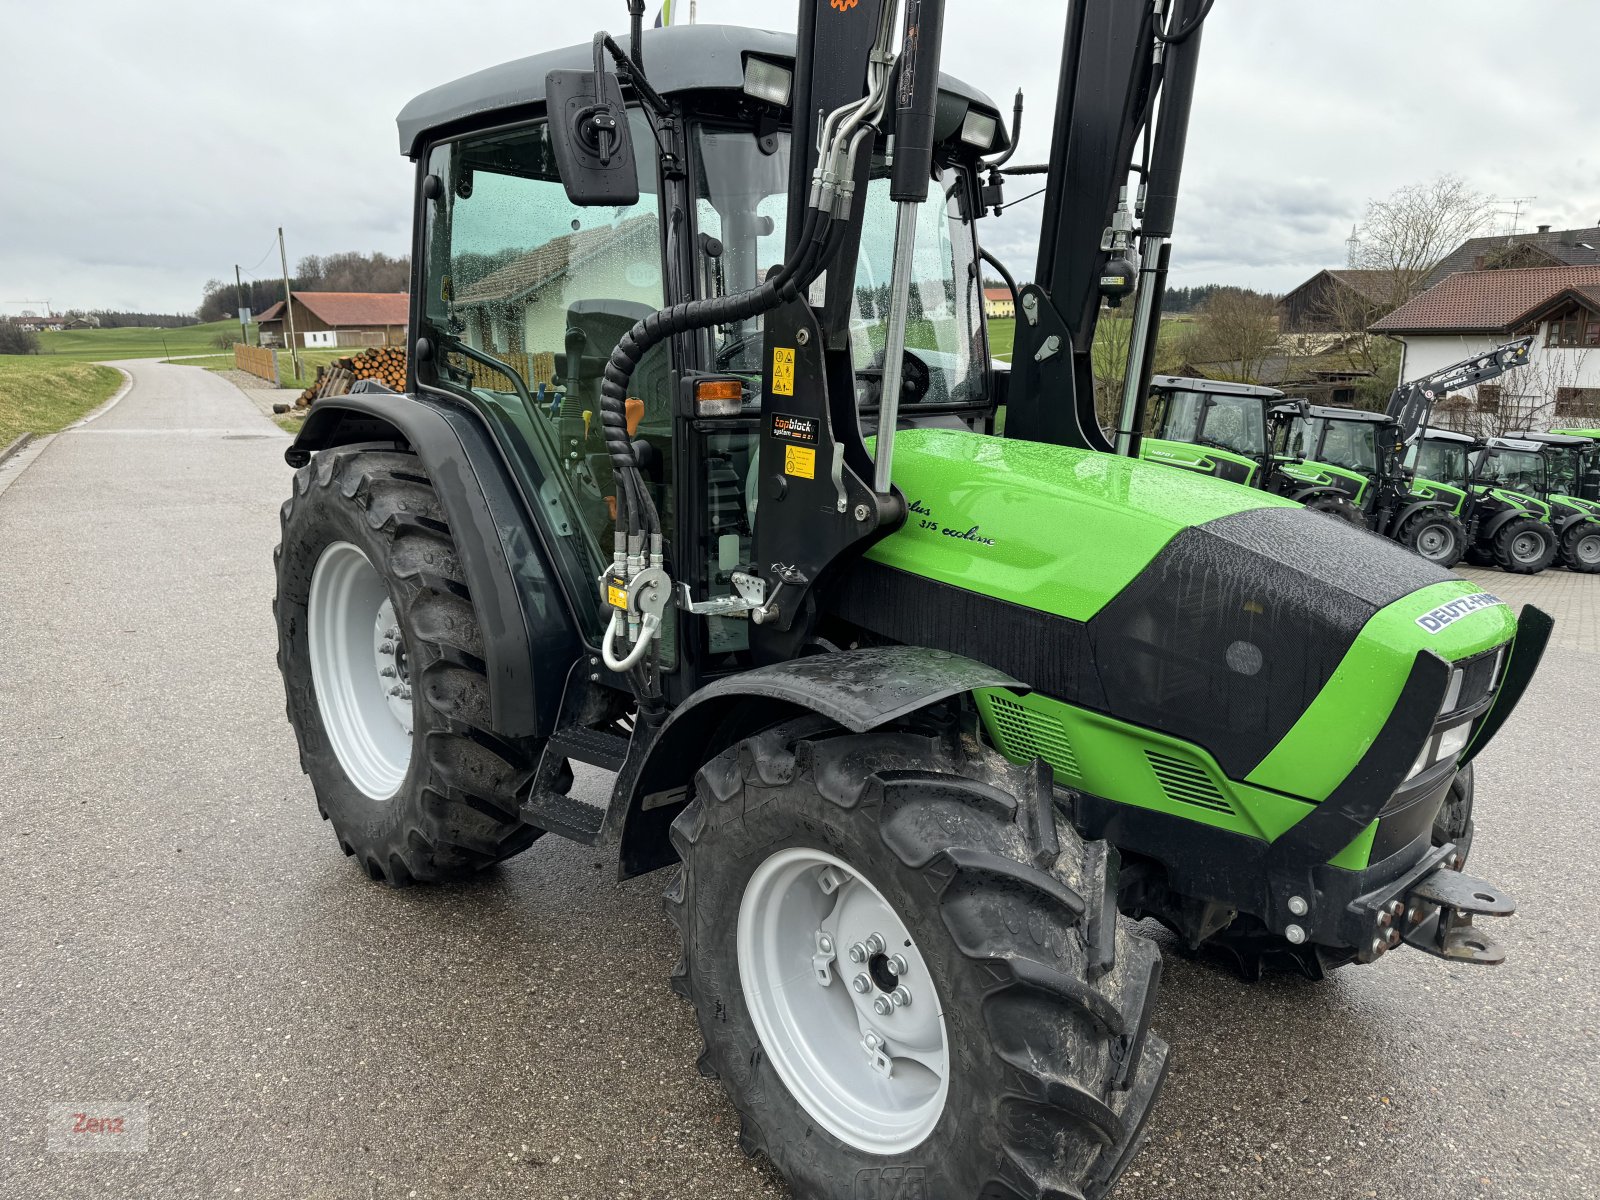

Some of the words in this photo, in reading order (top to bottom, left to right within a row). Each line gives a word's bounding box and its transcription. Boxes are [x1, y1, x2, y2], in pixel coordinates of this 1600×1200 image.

[773, 428, 792, 437] system
[907, 499, 931, 517] lus
[918, 519, 939, 531] 315
[941, 525, 996, 547] ecoline
[1418, 593, 1503, 632] DEUTZ-FA
